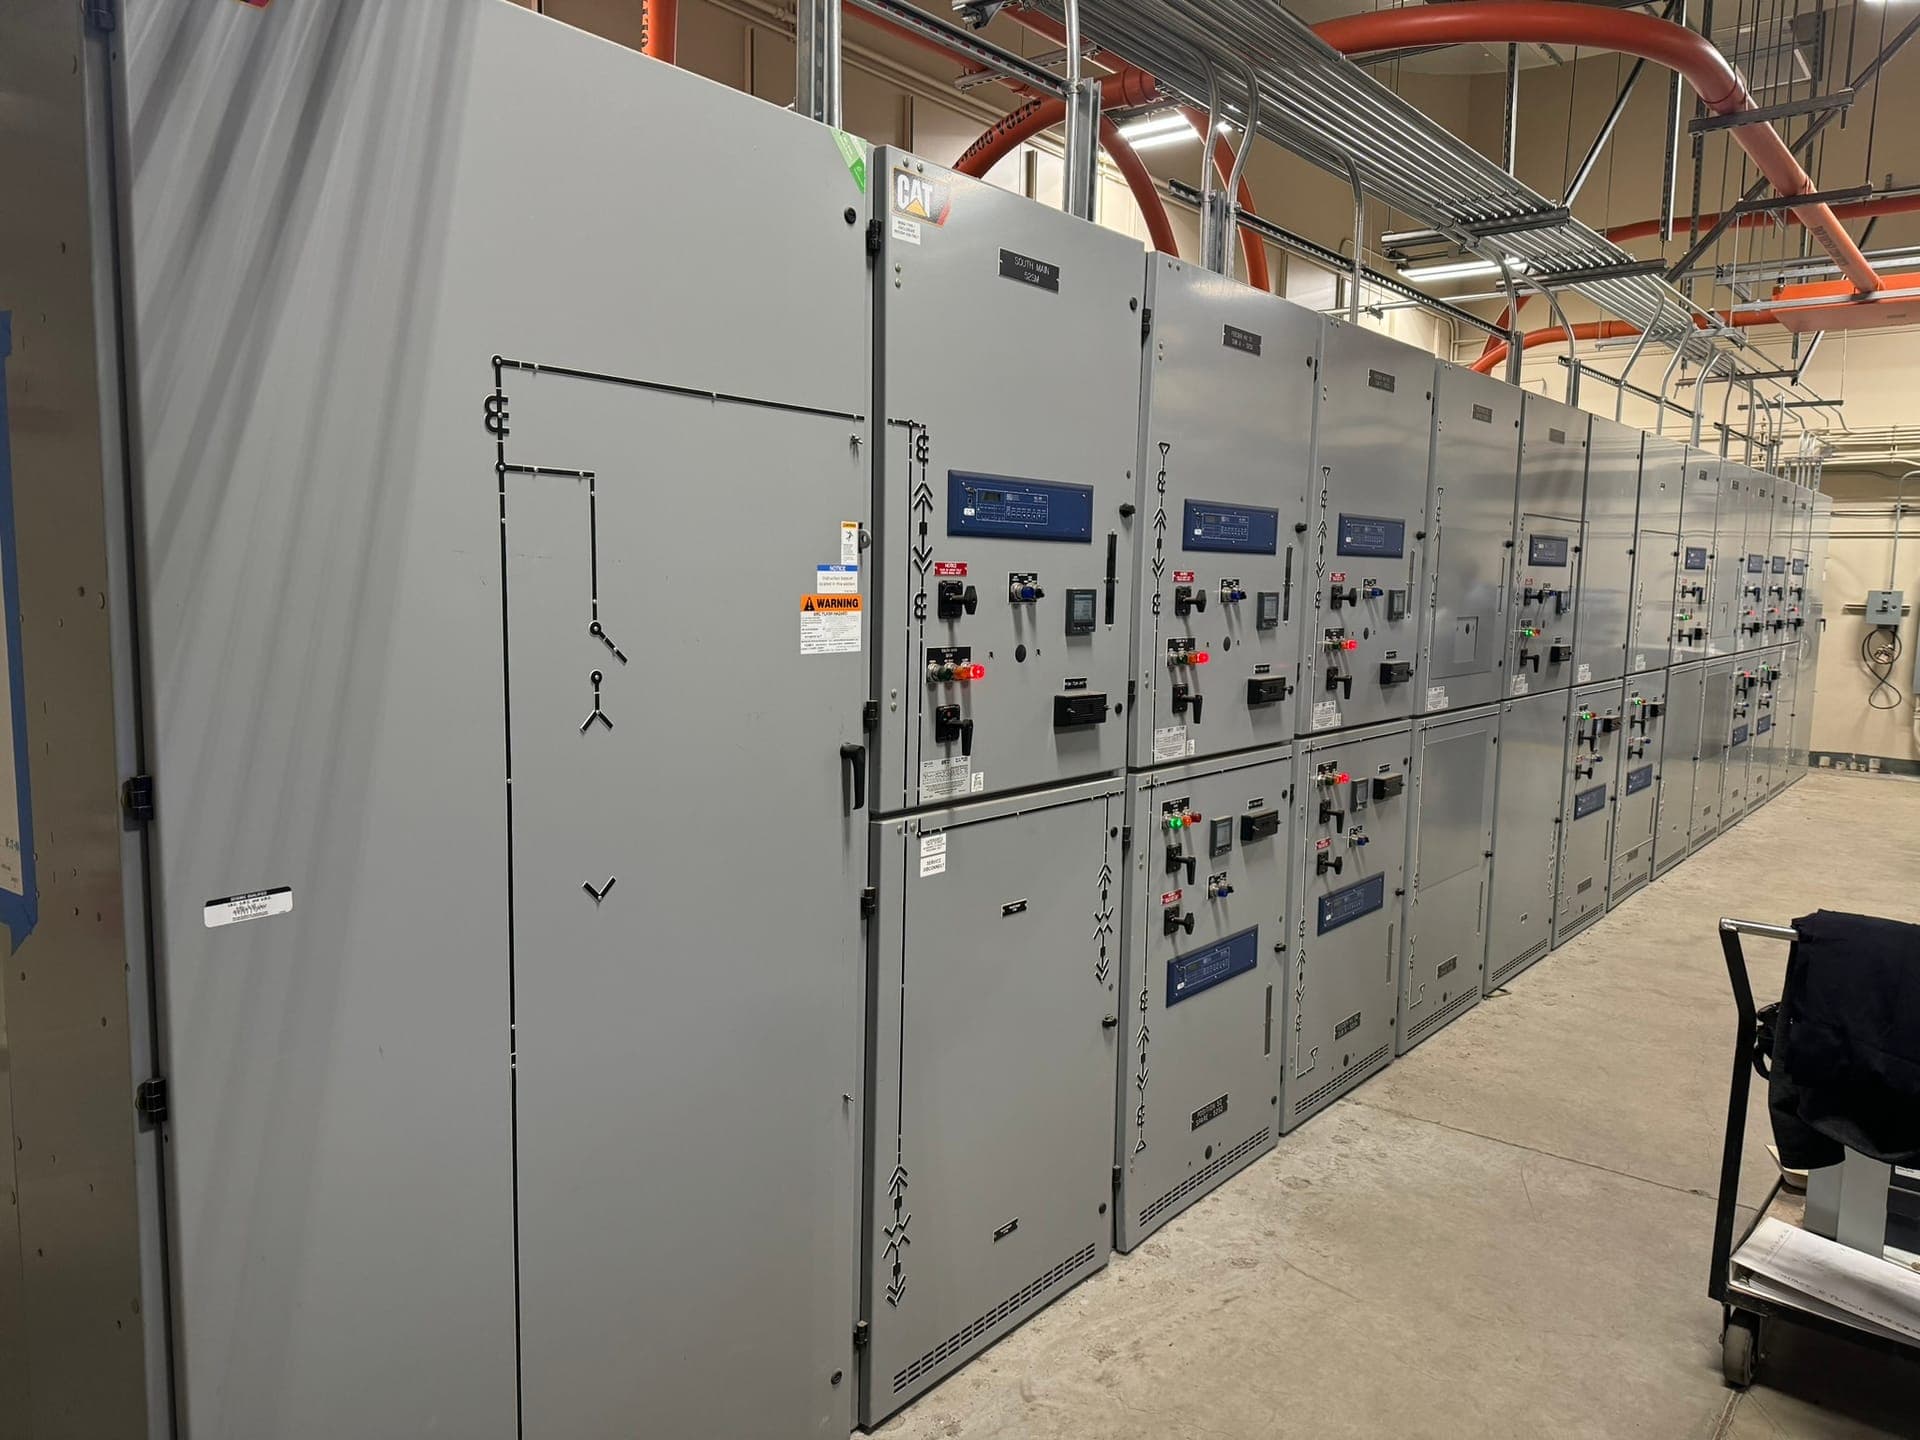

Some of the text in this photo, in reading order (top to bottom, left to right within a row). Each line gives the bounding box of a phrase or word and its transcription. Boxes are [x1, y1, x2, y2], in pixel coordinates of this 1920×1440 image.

[996, 99, 1042, 135] VOLTS
[897, 174, 933, 218] CAT
[1014, 256, 1050, 275] SOUTH MAIN
[816, 598, 859, 609] WARNING
